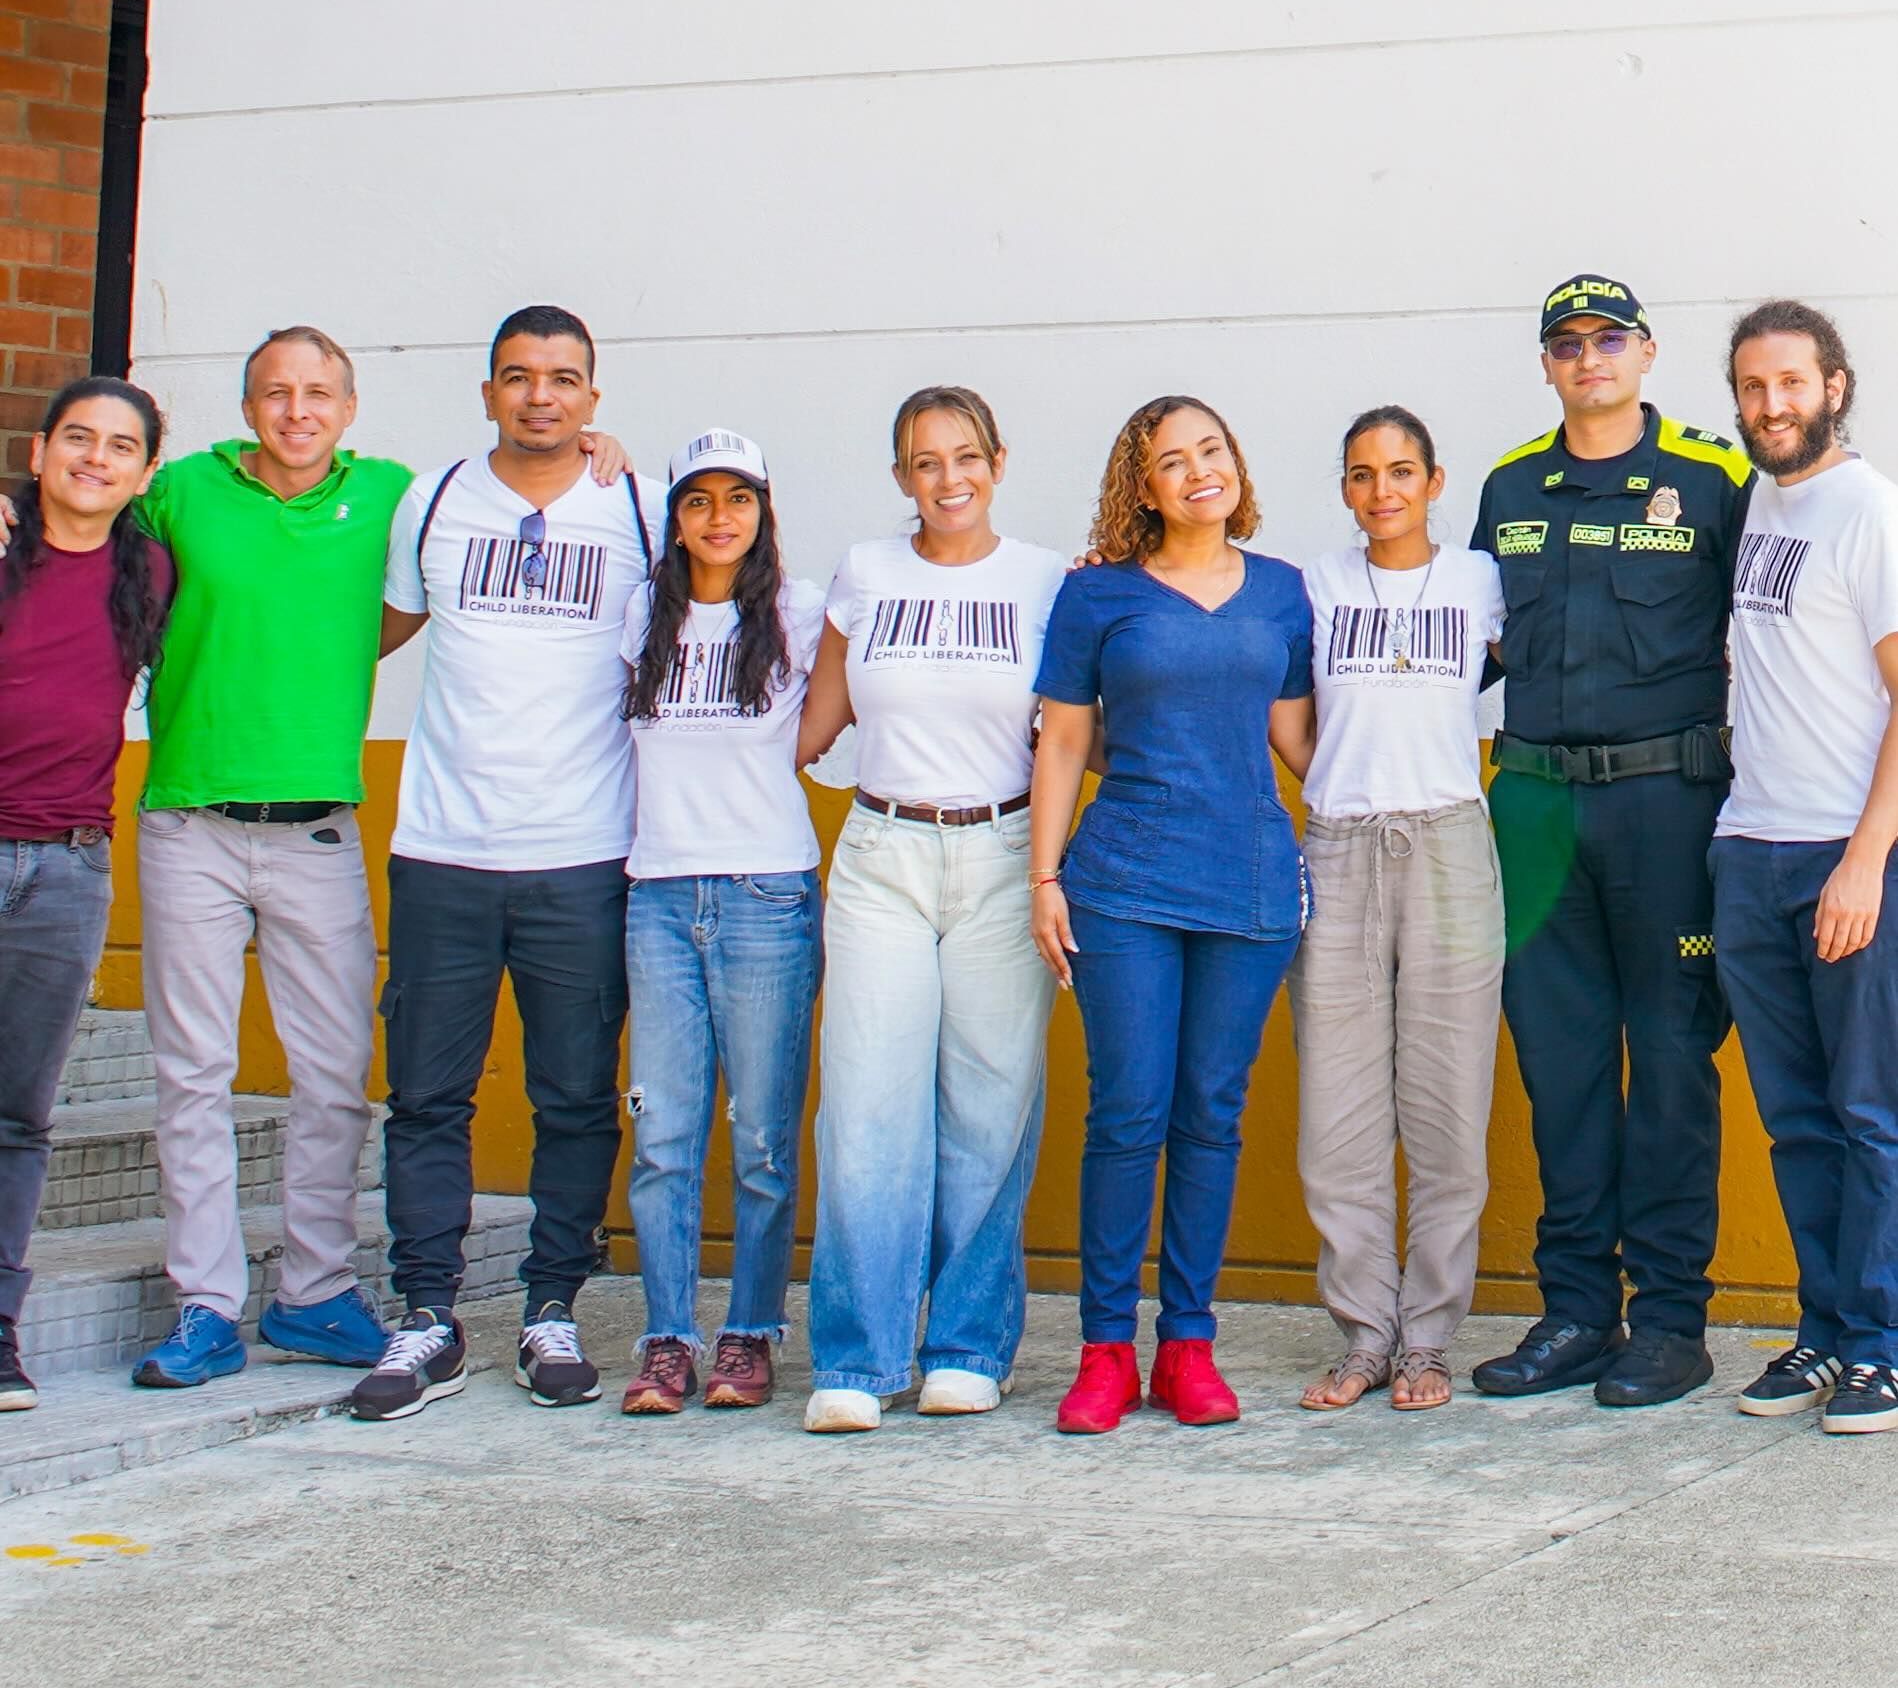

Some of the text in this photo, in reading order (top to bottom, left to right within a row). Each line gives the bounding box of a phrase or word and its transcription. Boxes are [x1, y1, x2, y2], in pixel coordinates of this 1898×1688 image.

[469, 601, 588, 620] CHILD LIBERATION
[874, 650, 1011, 663] CHILD LIBERATION
[1336, 663, 1375, 675] CHILD
